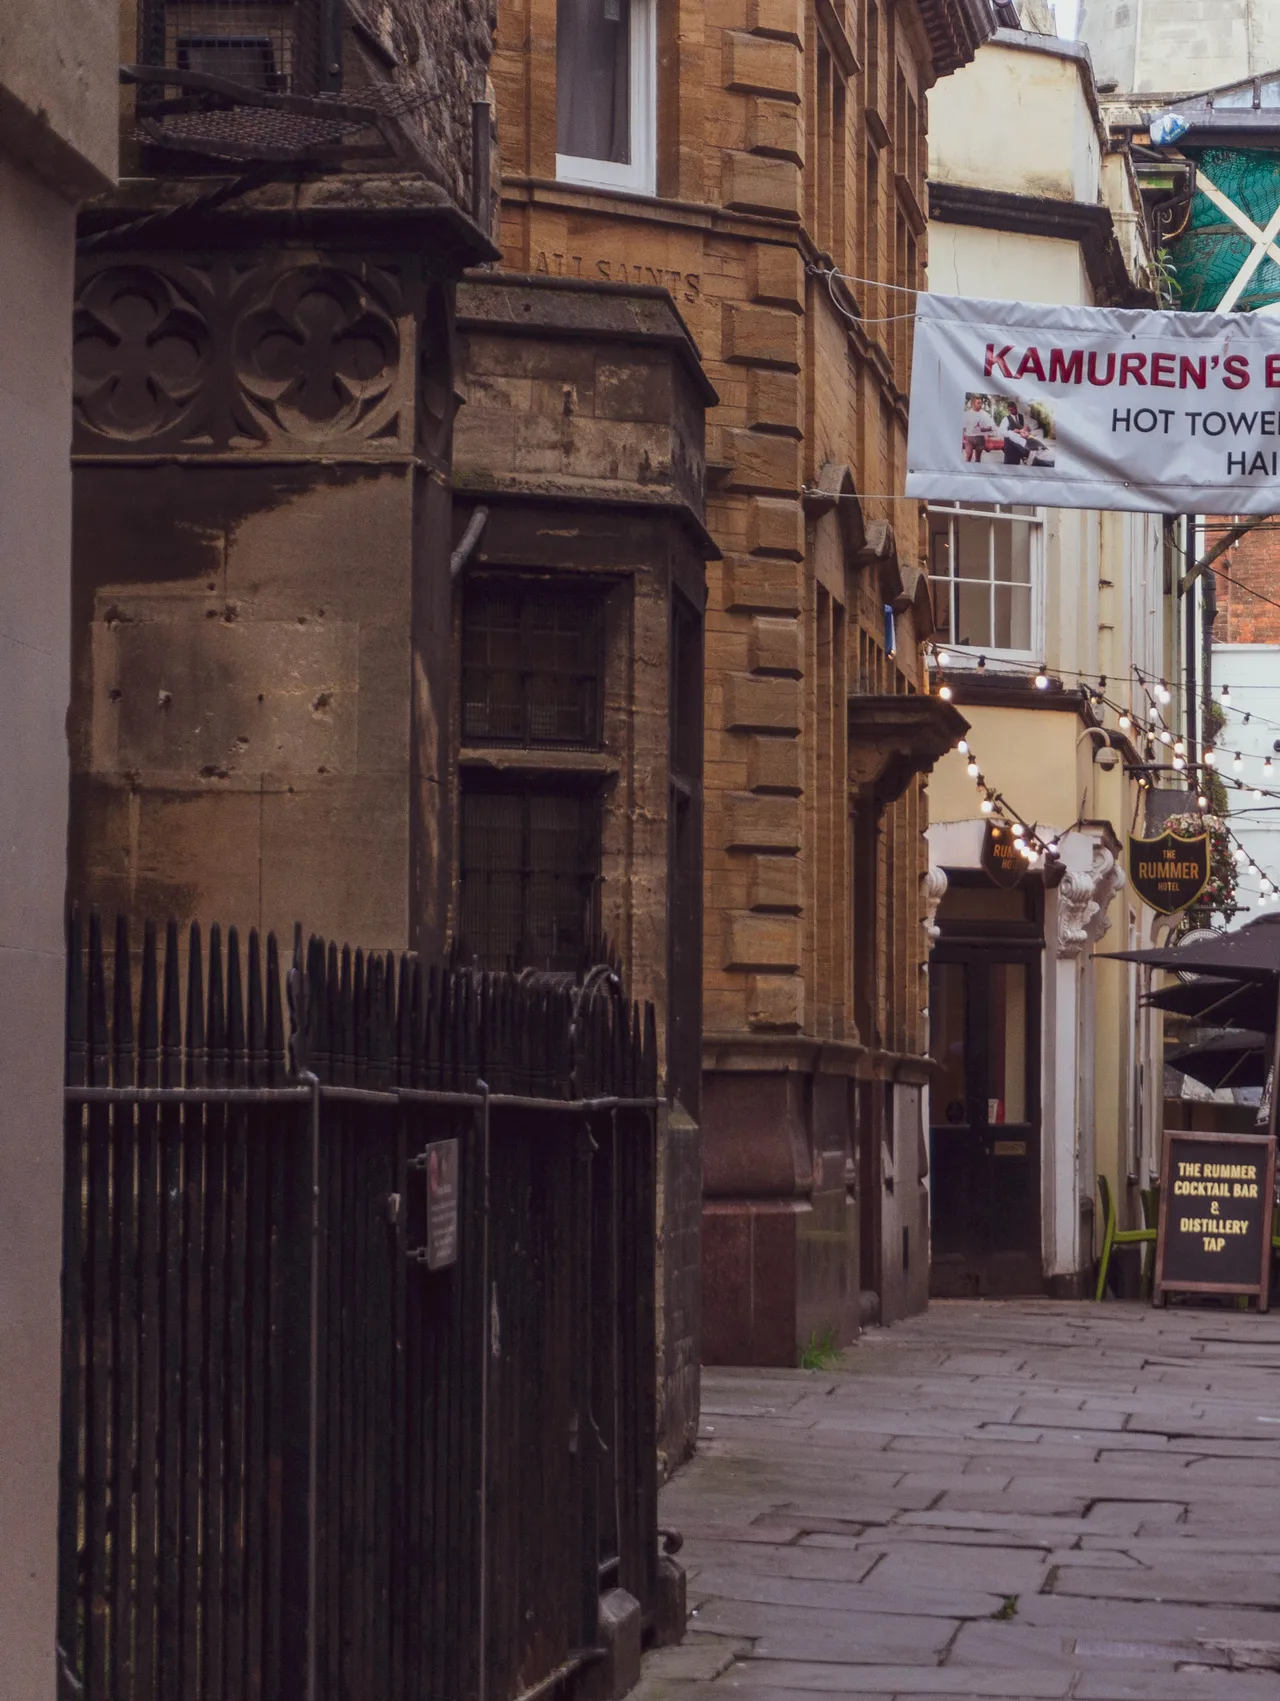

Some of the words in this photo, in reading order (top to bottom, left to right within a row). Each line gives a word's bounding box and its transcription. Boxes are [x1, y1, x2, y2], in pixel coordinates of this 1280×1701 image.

[984, 343, 1250, 390] KAMUREN'S
[1112, 408, 1175, 434] HOT
[1163, 850, 1176, 859] THE
[1139, 862, 1199, 879] RUMMER
[1158, 881, 1180, 891] HOTEL
[1178, 1162, 1201, 1177] THE
[1203, 1163, 1257, 1179] RUMMER
[1174, 1181, 1230, 1197] COCKTAIL
[1233, 1183, 1258, 1198] BAR
[1210, 1201, 1220, 1215] &
[1180, 1218, 1249, 1234] DISTILLERY
[1203, 1237, 1226, 1252] TAP
